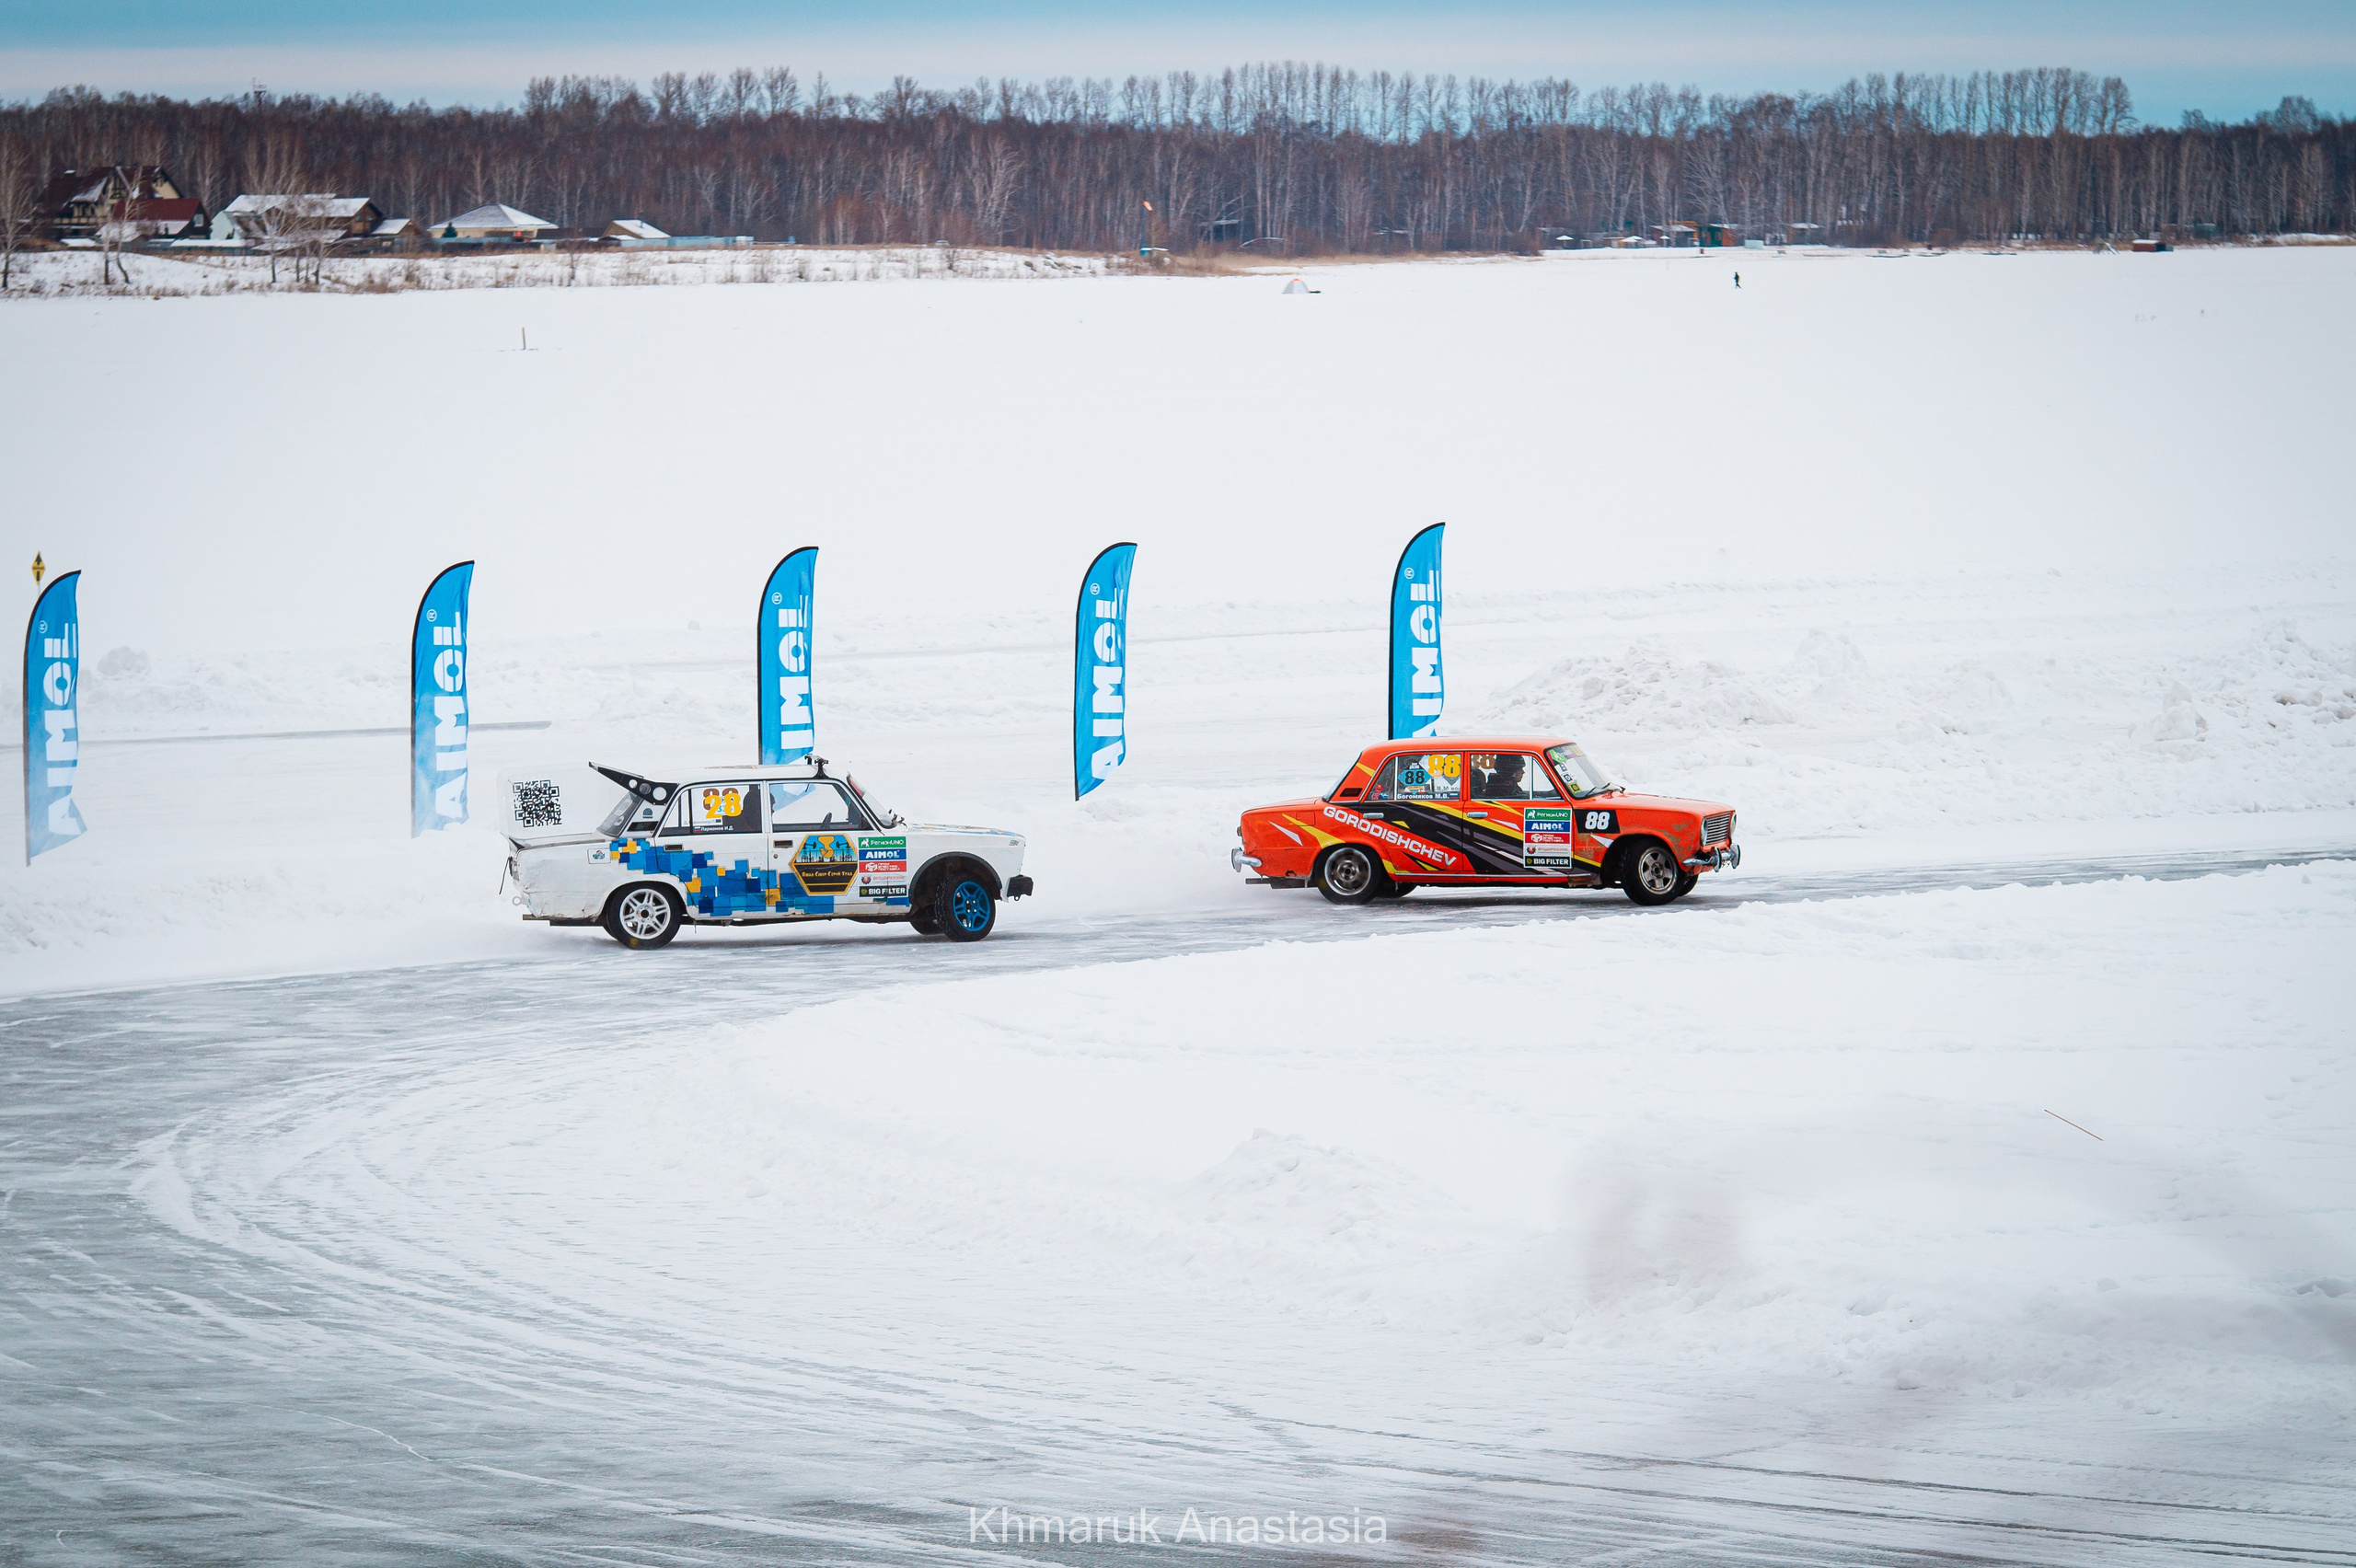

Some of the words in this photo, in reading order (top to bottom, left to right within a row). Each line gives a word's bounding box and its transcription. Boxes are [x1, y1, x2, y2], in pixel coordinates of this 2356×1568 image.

[1091, 587, 1124, 780] AIMOL
[433, 611, 468, 819] AIMOL
[1404, 771, 1425, 784] 88
[1427, 755, 1461, 778] 88
[705, 793, 742, 819] 28
[1585, 812, 1610, 830] 88
[1323, 806, 1457, 866] GORODISHCHEV
[865, 850, 899, 859] AIMOL
